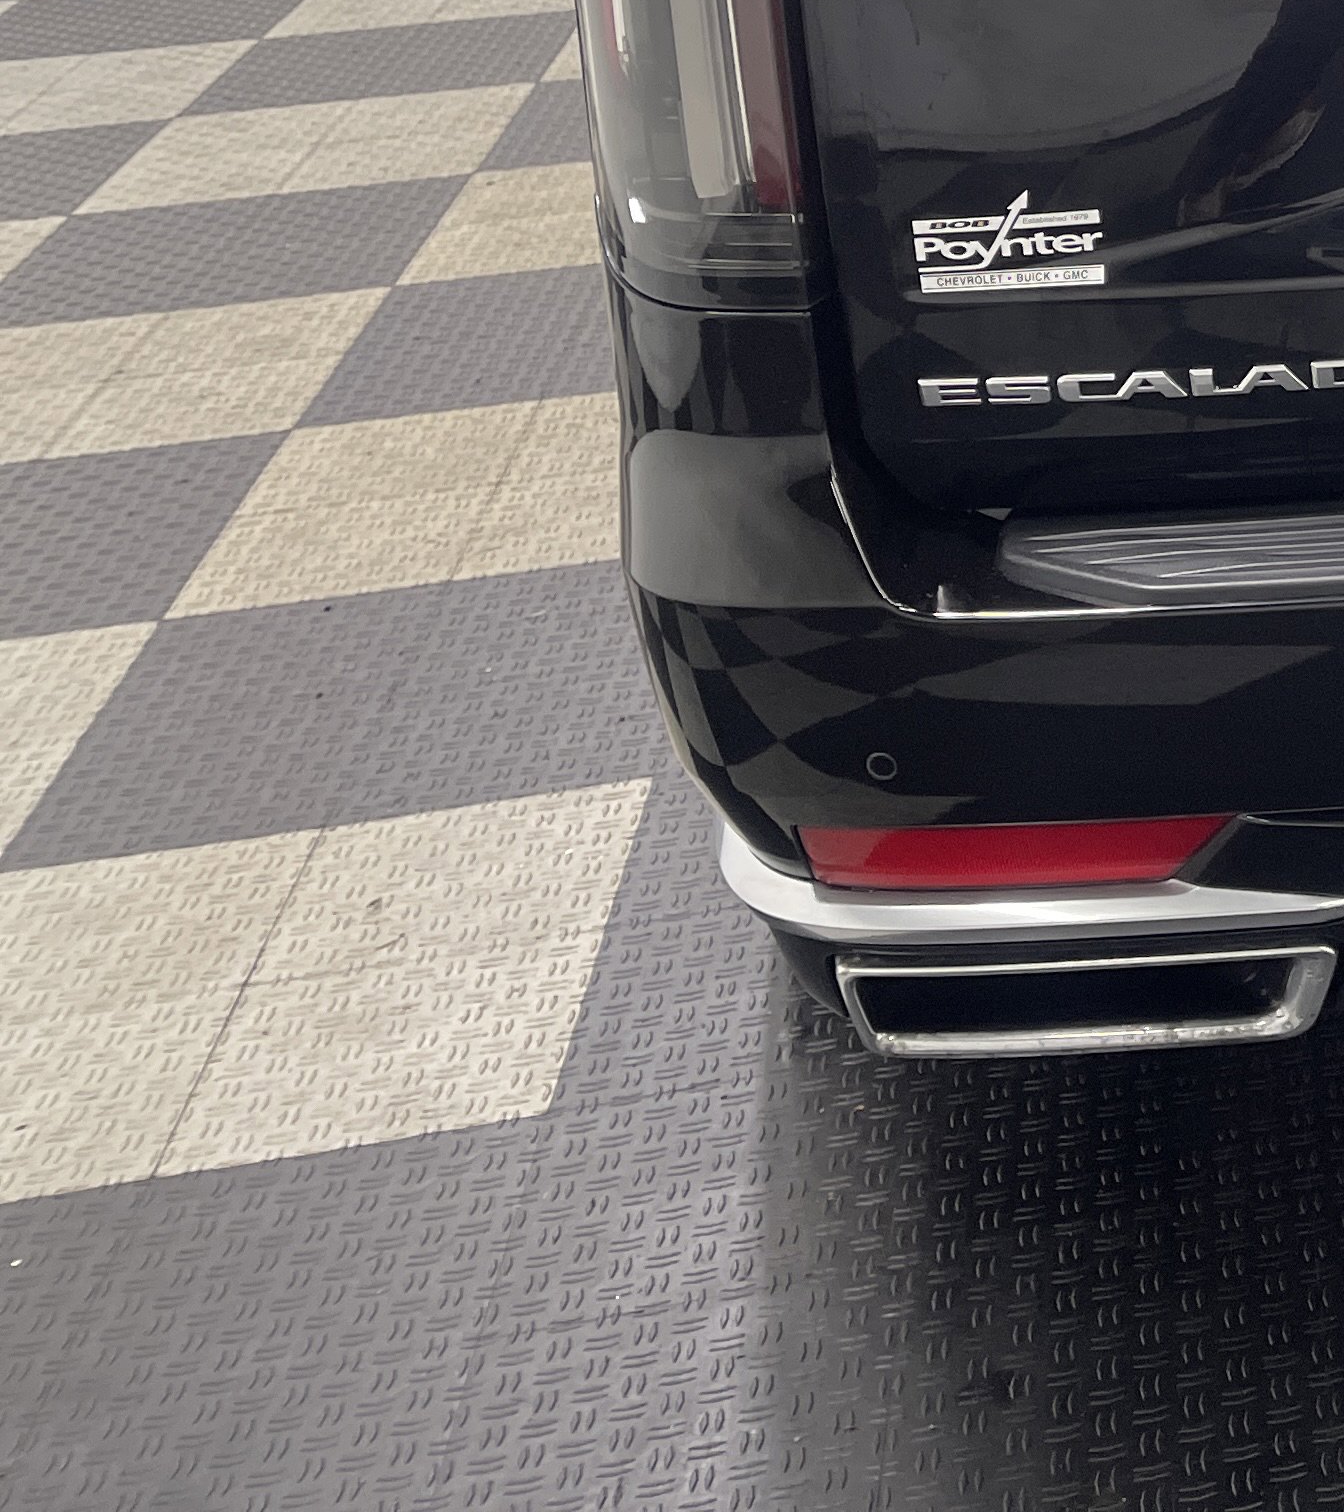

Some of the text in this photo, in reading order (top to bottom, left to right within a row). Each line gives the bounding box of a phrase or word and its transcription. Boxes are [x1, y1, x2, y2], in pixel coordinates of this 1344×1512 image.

[929, 219, 990, 230] BOB
[913, 231, 1103, 273] Poynter
[936, 269, 1089, 286] CHEVROLET BUICK GMC
